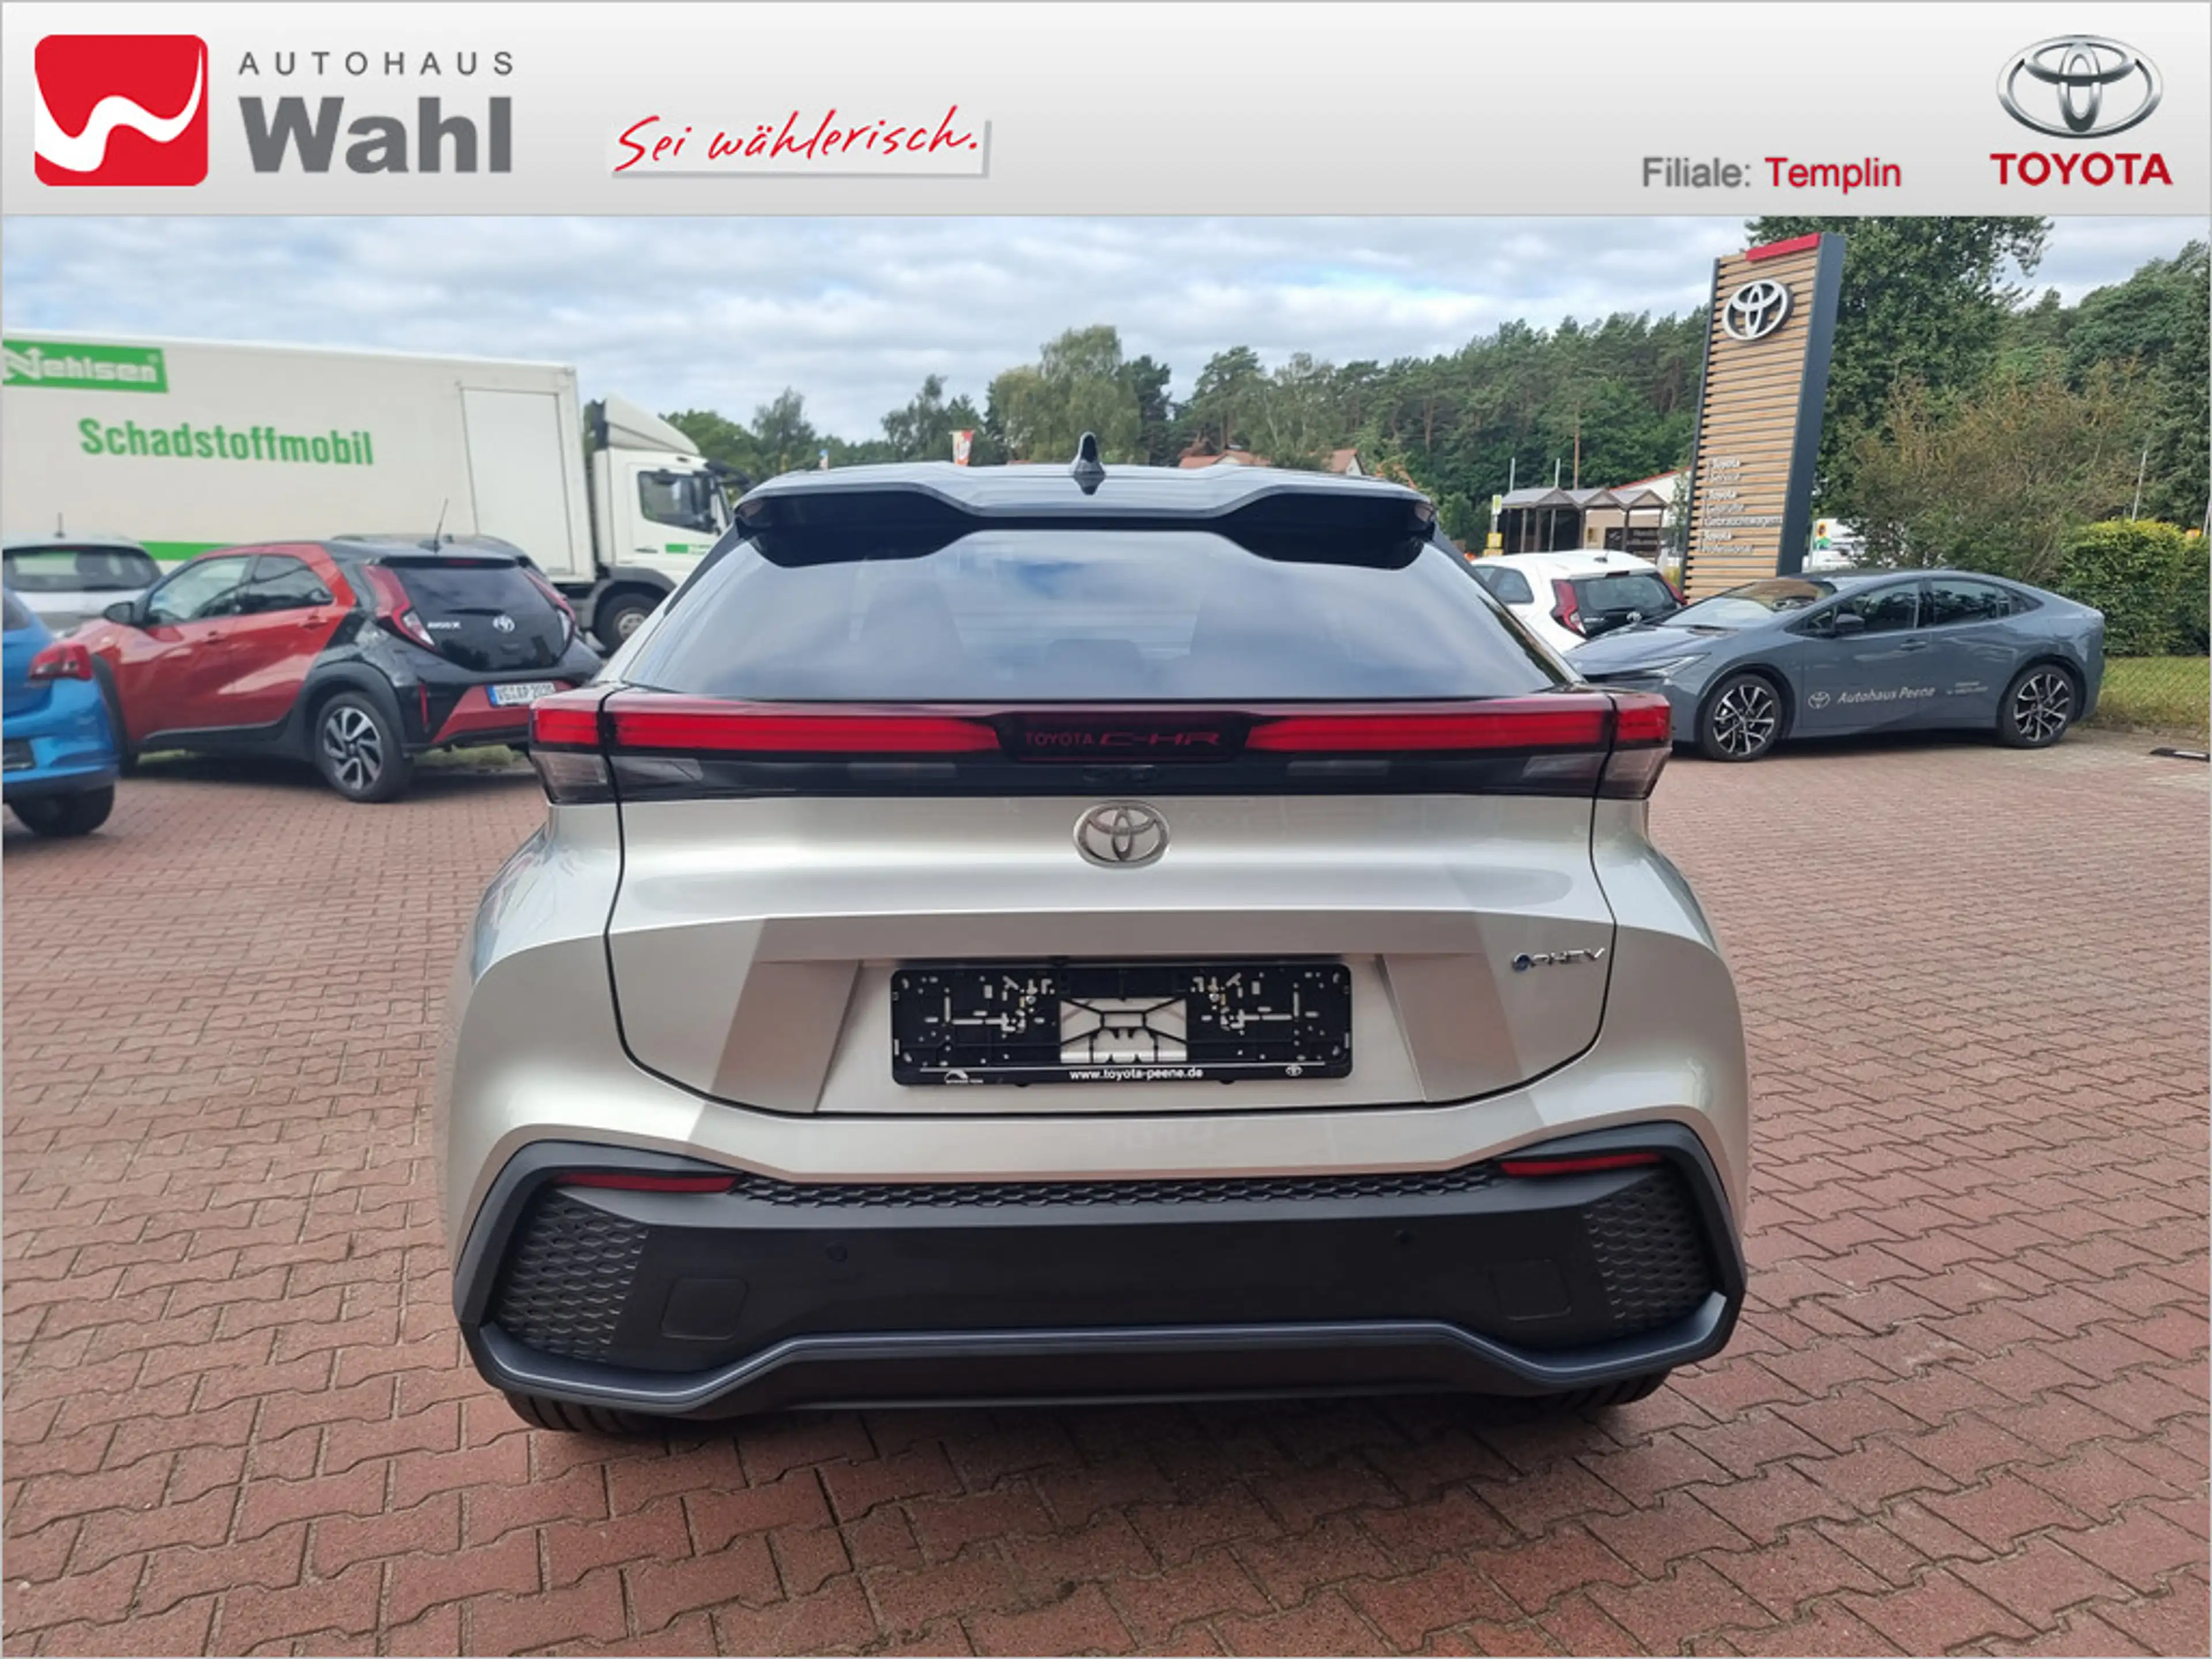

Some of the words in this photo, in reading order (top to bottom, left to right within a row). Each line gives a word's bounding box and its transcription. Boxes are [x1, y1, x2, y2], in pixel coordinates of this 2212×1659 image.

[3, 346, 158, 383] Nehlsen
[79, 418, 373, 464] Schadstoffmobil
[1838, 689, 1896, 704] Autohaus
[1899, 687, 1936, 699] Peene
[1025, 732, 1094, 746] TOYOTA
[1099, 732, 1221, 746] C-HR
[1069, 1067, 1204, 1081] www.toyota-peene.de
